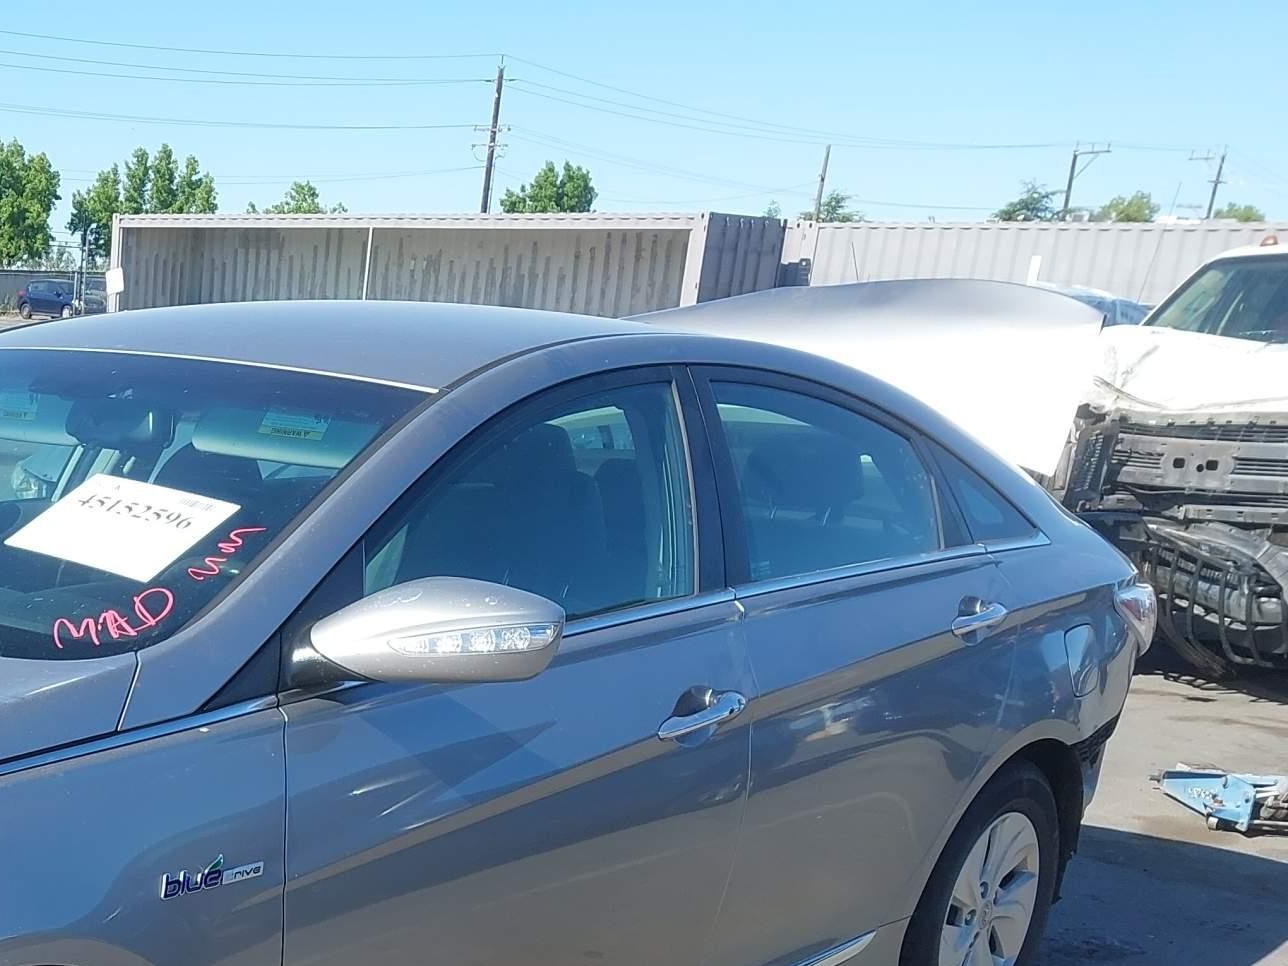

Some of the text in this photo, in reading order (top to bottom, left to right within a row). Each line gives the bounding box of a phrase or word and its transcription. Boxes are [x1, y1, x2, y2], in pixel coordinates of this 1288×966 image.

[77, 494, 193, 530] 45152596
[160, 864, 262, 901] blue rive
